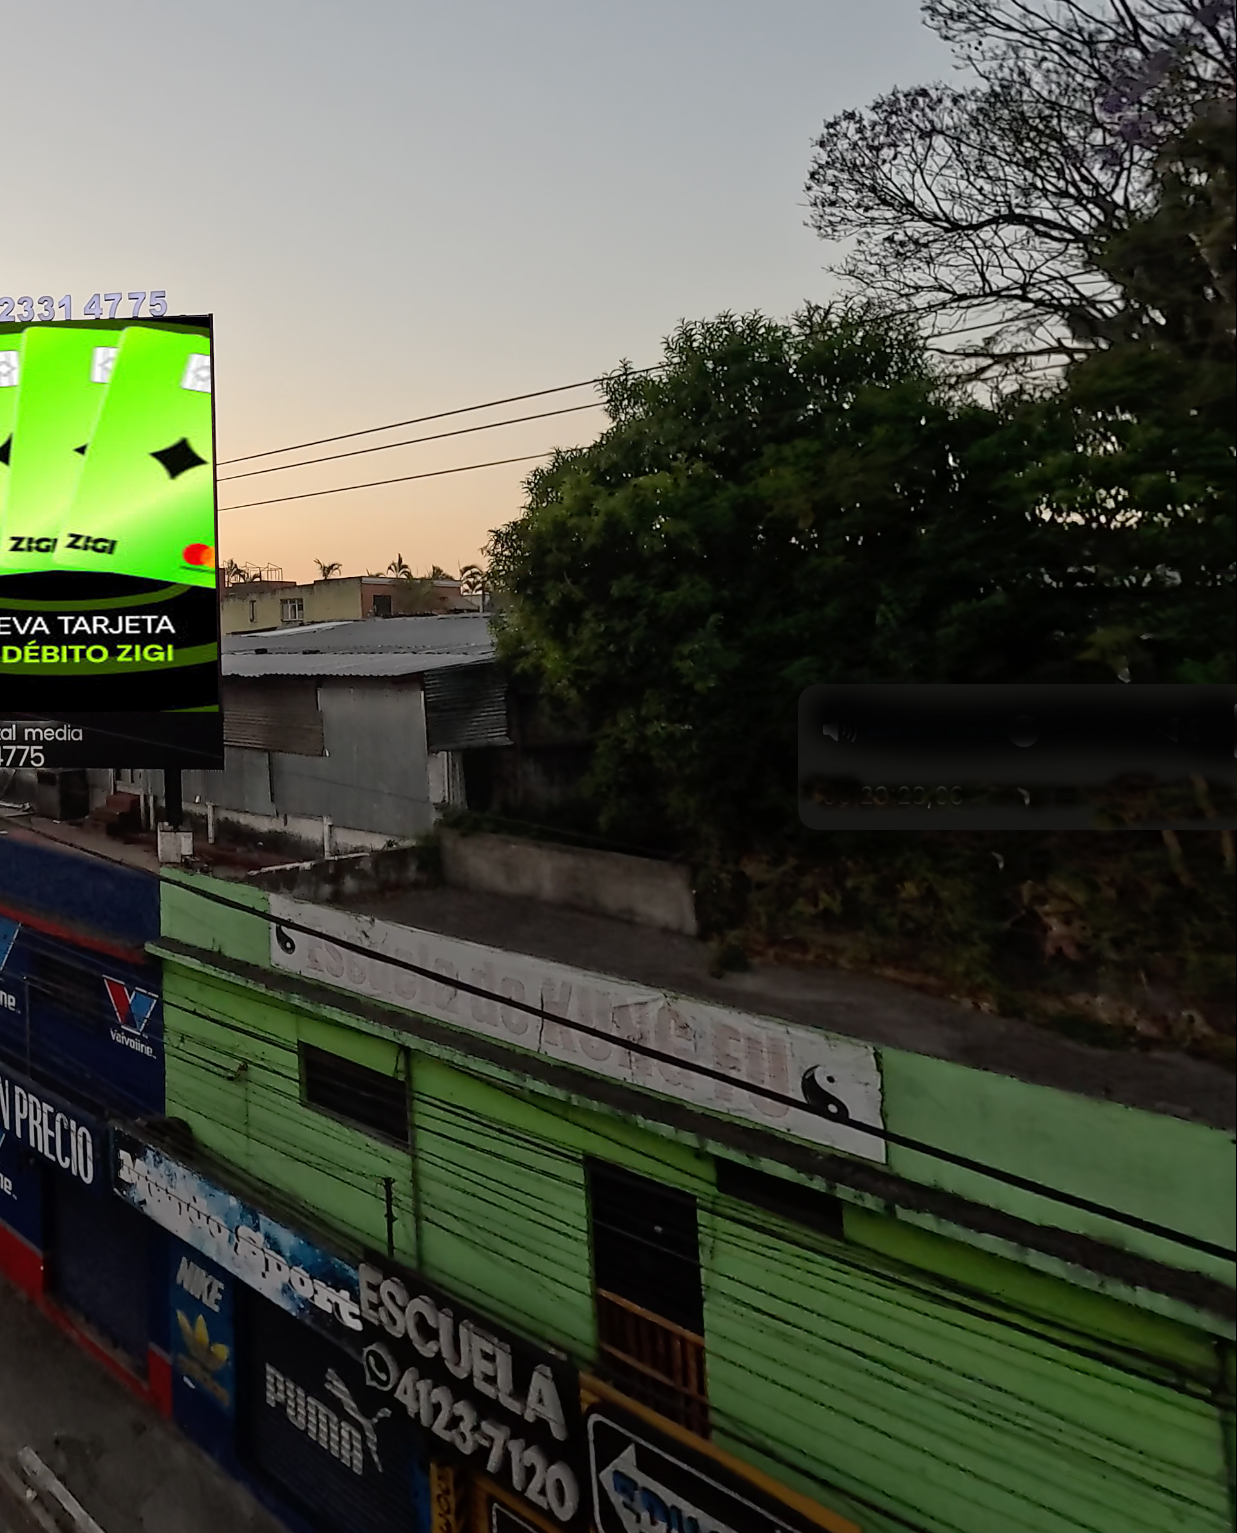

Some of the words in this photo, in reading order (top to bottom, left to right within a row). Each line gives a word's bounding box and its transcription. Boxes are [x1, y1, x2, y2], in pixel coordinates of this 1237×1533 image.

[83, 290, 168, 320] 4775
[66, 533, 117, 556] ZIGI
[57, 615, 176, 635] TARJETA
[1, 640, 109, 664] DÉBITO
[116, 644, 174, 663] ZIGI
[24, 724, 83, 742] media
[14, 1085, 94, 1185] PRECIO
[175, 1256, 225, 1314] NIKE
[358, 1262, 568, 1441] ESCUELA
[265, 1362, 363, 1476] PUMA
[393, 1366, 580, 1522] 4123-7120
